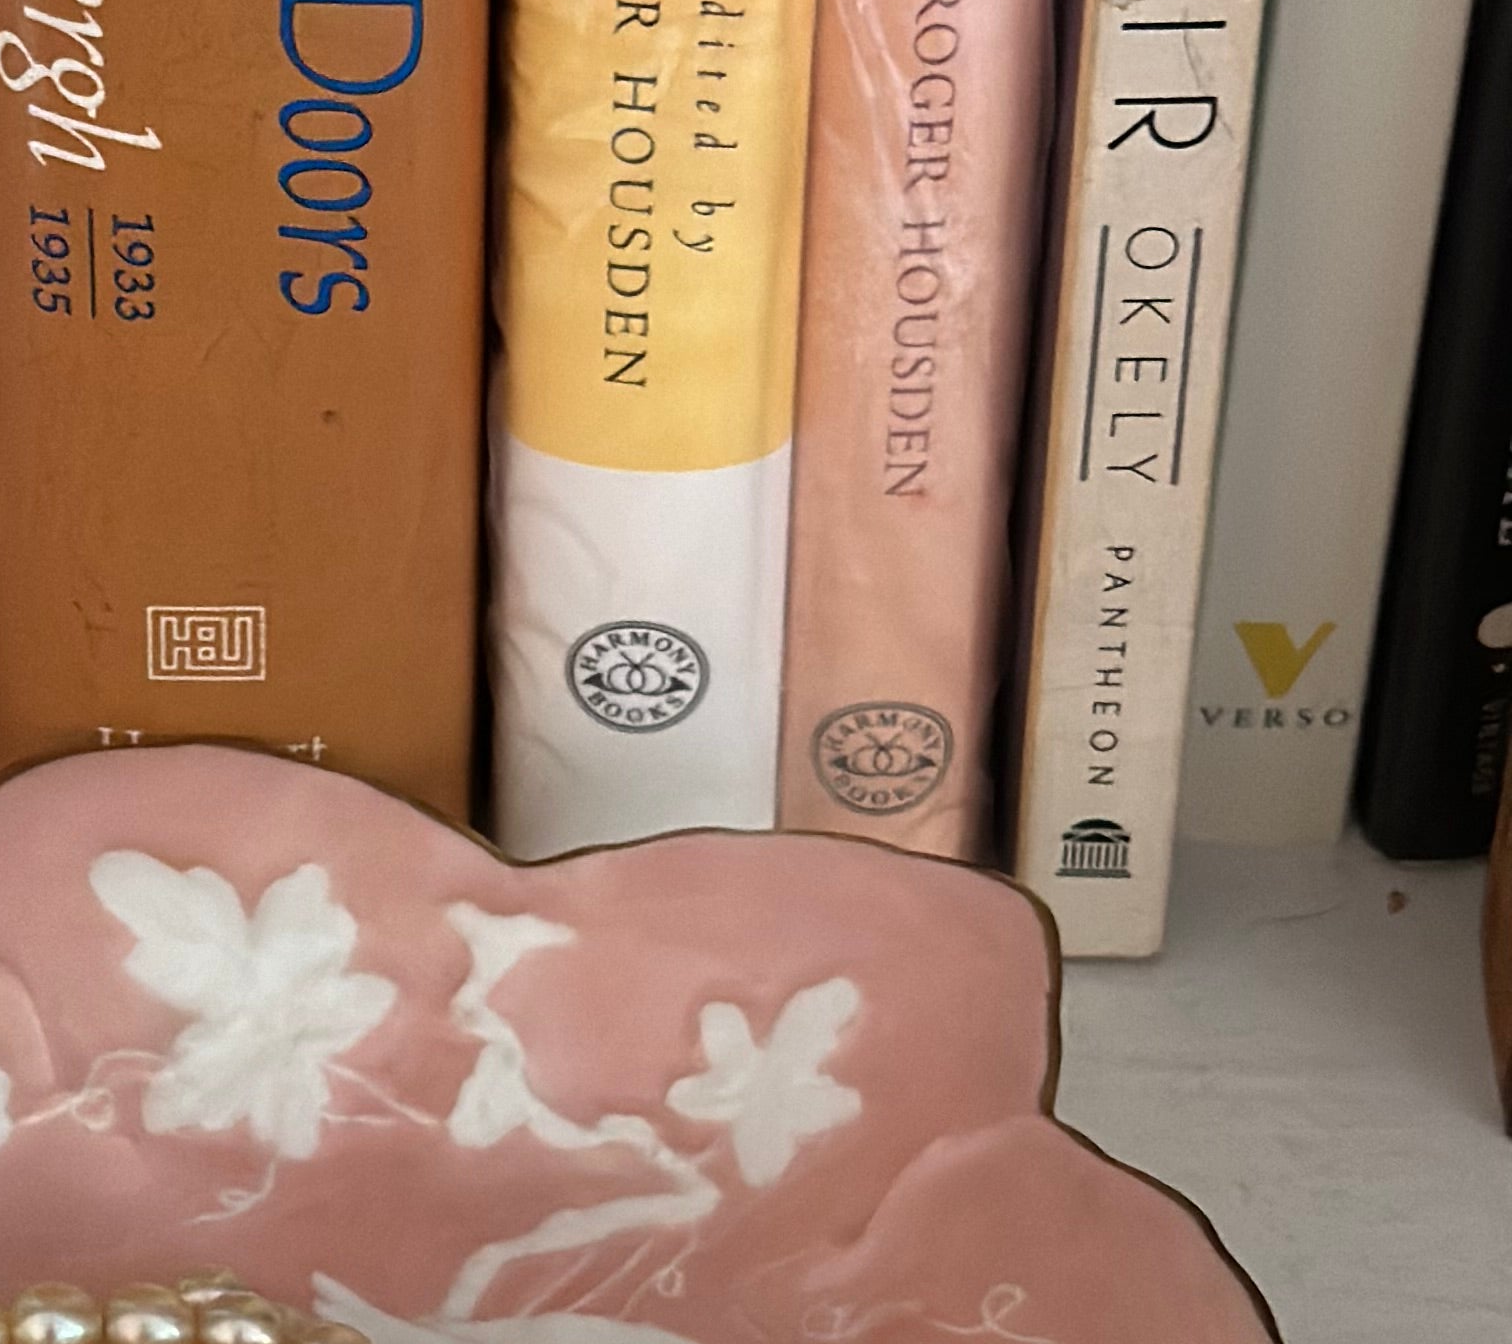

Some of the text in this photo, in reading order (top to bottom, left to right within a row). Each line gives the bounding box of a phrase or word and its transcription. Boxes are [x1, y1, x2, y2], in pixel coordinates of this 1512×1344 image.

[29, 205, 72, 318] 1935
[110, 211, 156, 325] 1933
[604, 71, 658, 388] HOUSDEN
[673, 200, 735, 253] by
[883, 219, 945, 499] HOUSDEN
[1107, 226, 1180, 484] OKELY
[579, 630, 696, 675] HARMONY
[587, 692, 685, 723] BOOKS
[1088, 546, 1136, 786] PANTHEON
[824, 711, 942, 751] HARMONY
[1200, 706, 1353, 728] VERSO
